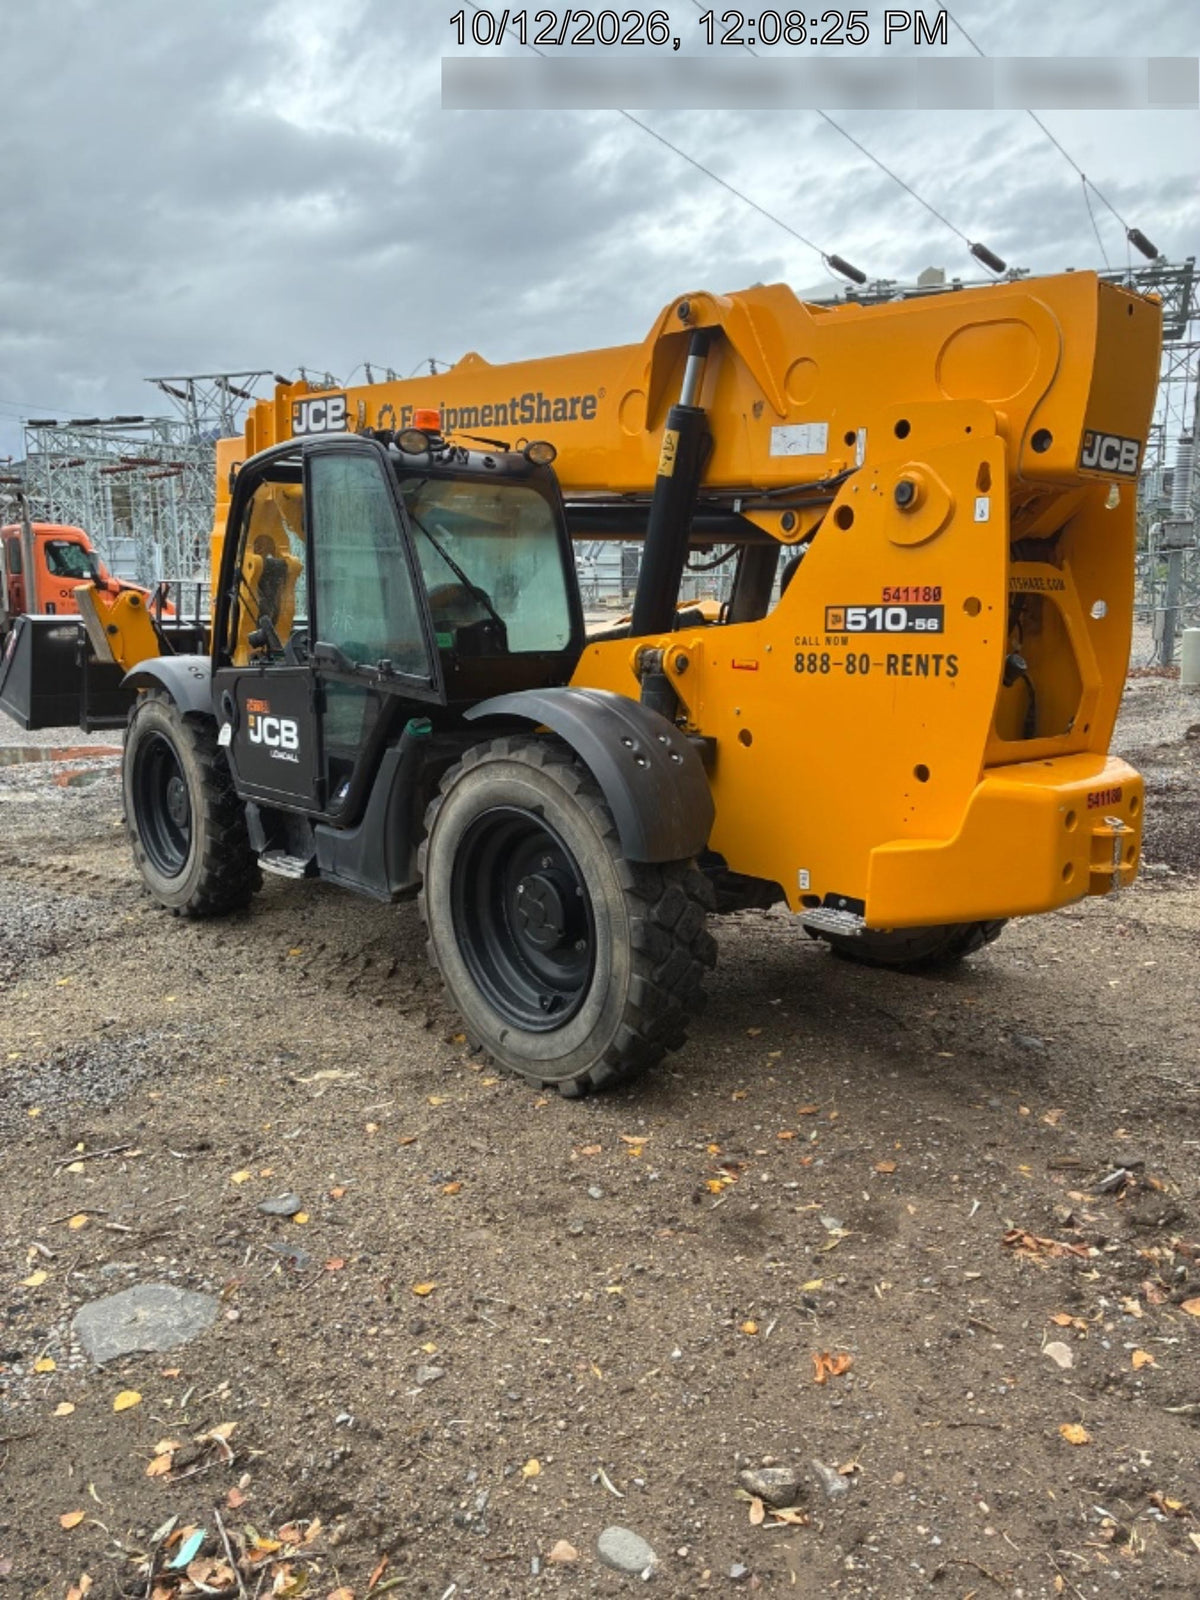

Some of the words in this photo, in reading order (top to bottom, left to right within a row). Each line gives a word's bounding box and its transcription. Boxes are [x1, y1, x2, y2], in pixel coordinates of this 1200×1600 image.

[293, 398, 345, 433] JCB
[401, 391, 597, 435] EipmentShare
[1083, 435, 1138, 472] JCB
[882, 586, 942, 602] 541180
[794, 636, 820, 646] CALL
[825, 636, 849, 646] NOW
[249, 715, 299, 749] JCB
